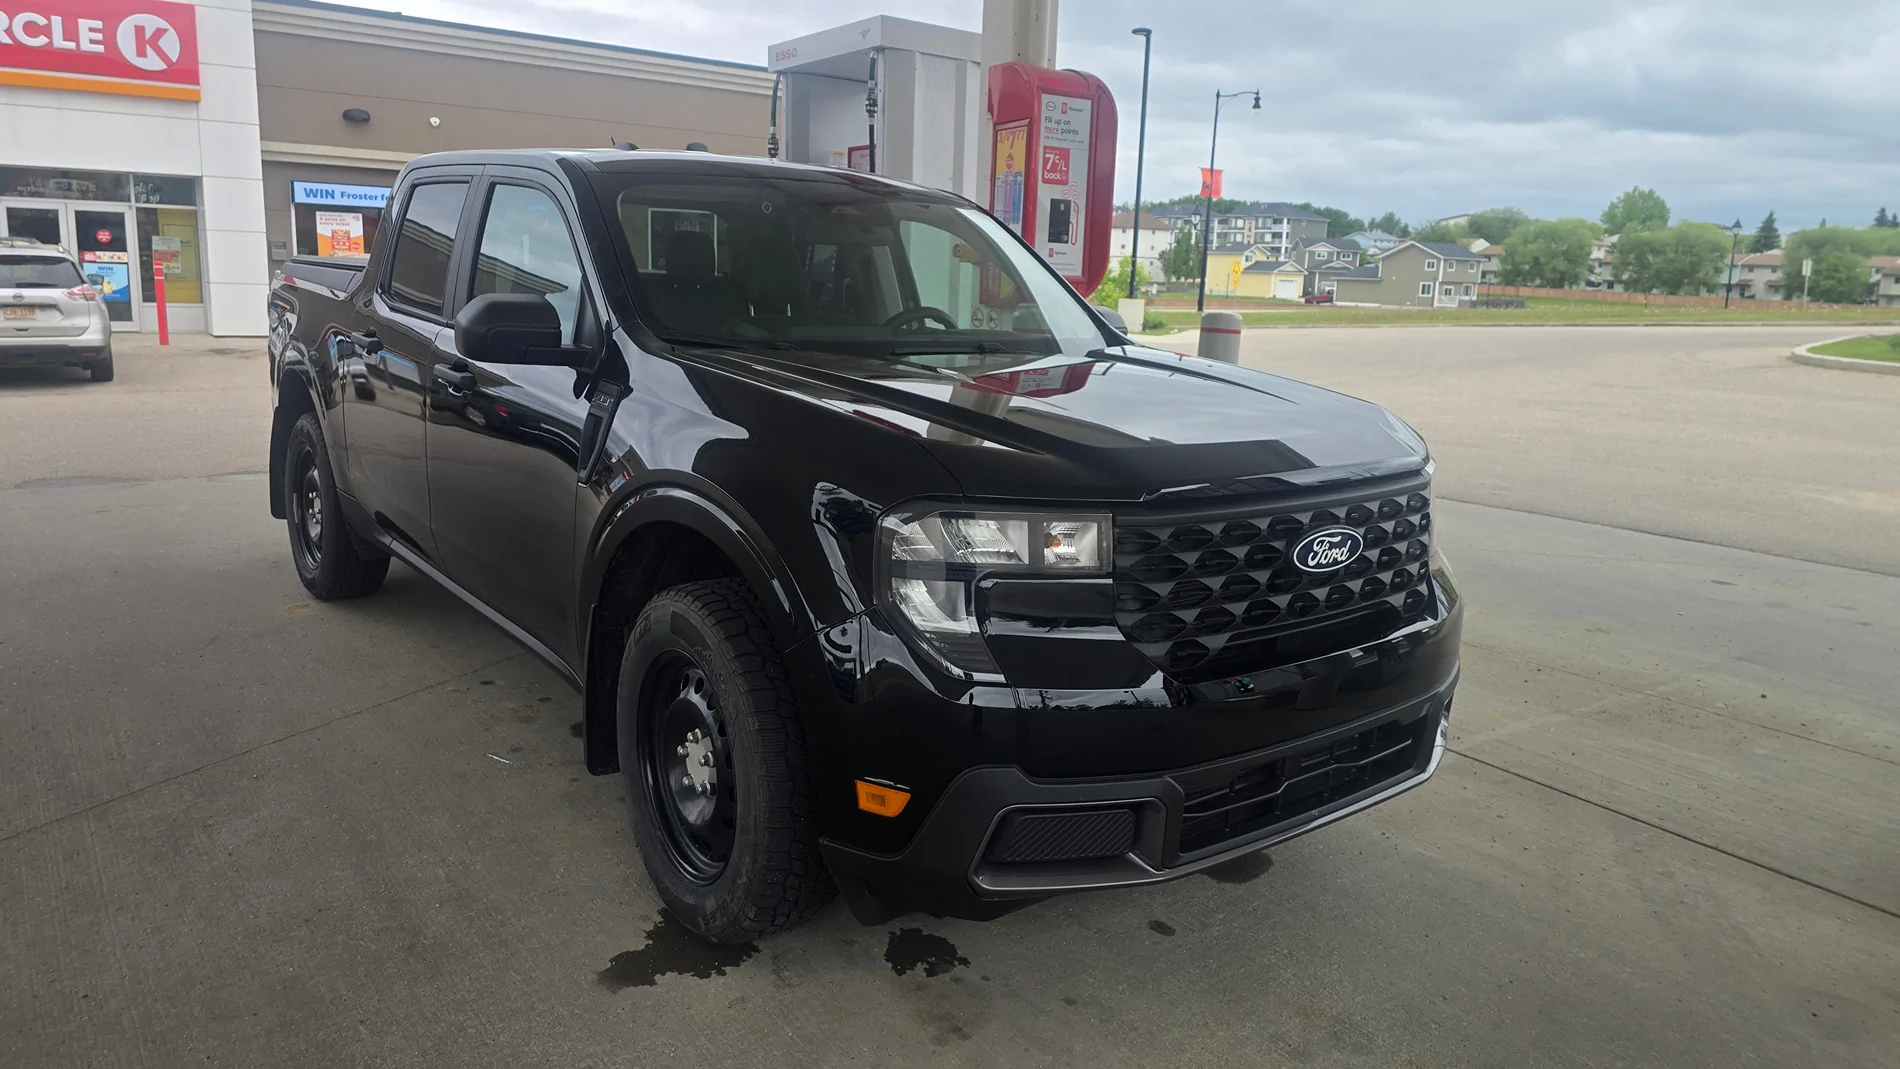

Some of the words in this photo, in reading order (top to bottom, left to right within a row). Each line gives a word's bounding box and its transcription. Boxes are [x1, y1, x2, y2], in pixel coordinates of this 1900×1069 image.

[134, 24, 177, 68] K
[776, 47, 798, 62] ESSO
[1044, 115, 1053, 123] Fill
[1053, 118, 1062, 126] up
[1044, 125, 1059, 134] more
[1060, 127, 1079, 136] points
[1044, 170, 1062, 180] back
[303, 187, 335, 200] WIN
[340, 191, 379, 201] Froster
[1307, 535, 1352, 567] Ford
